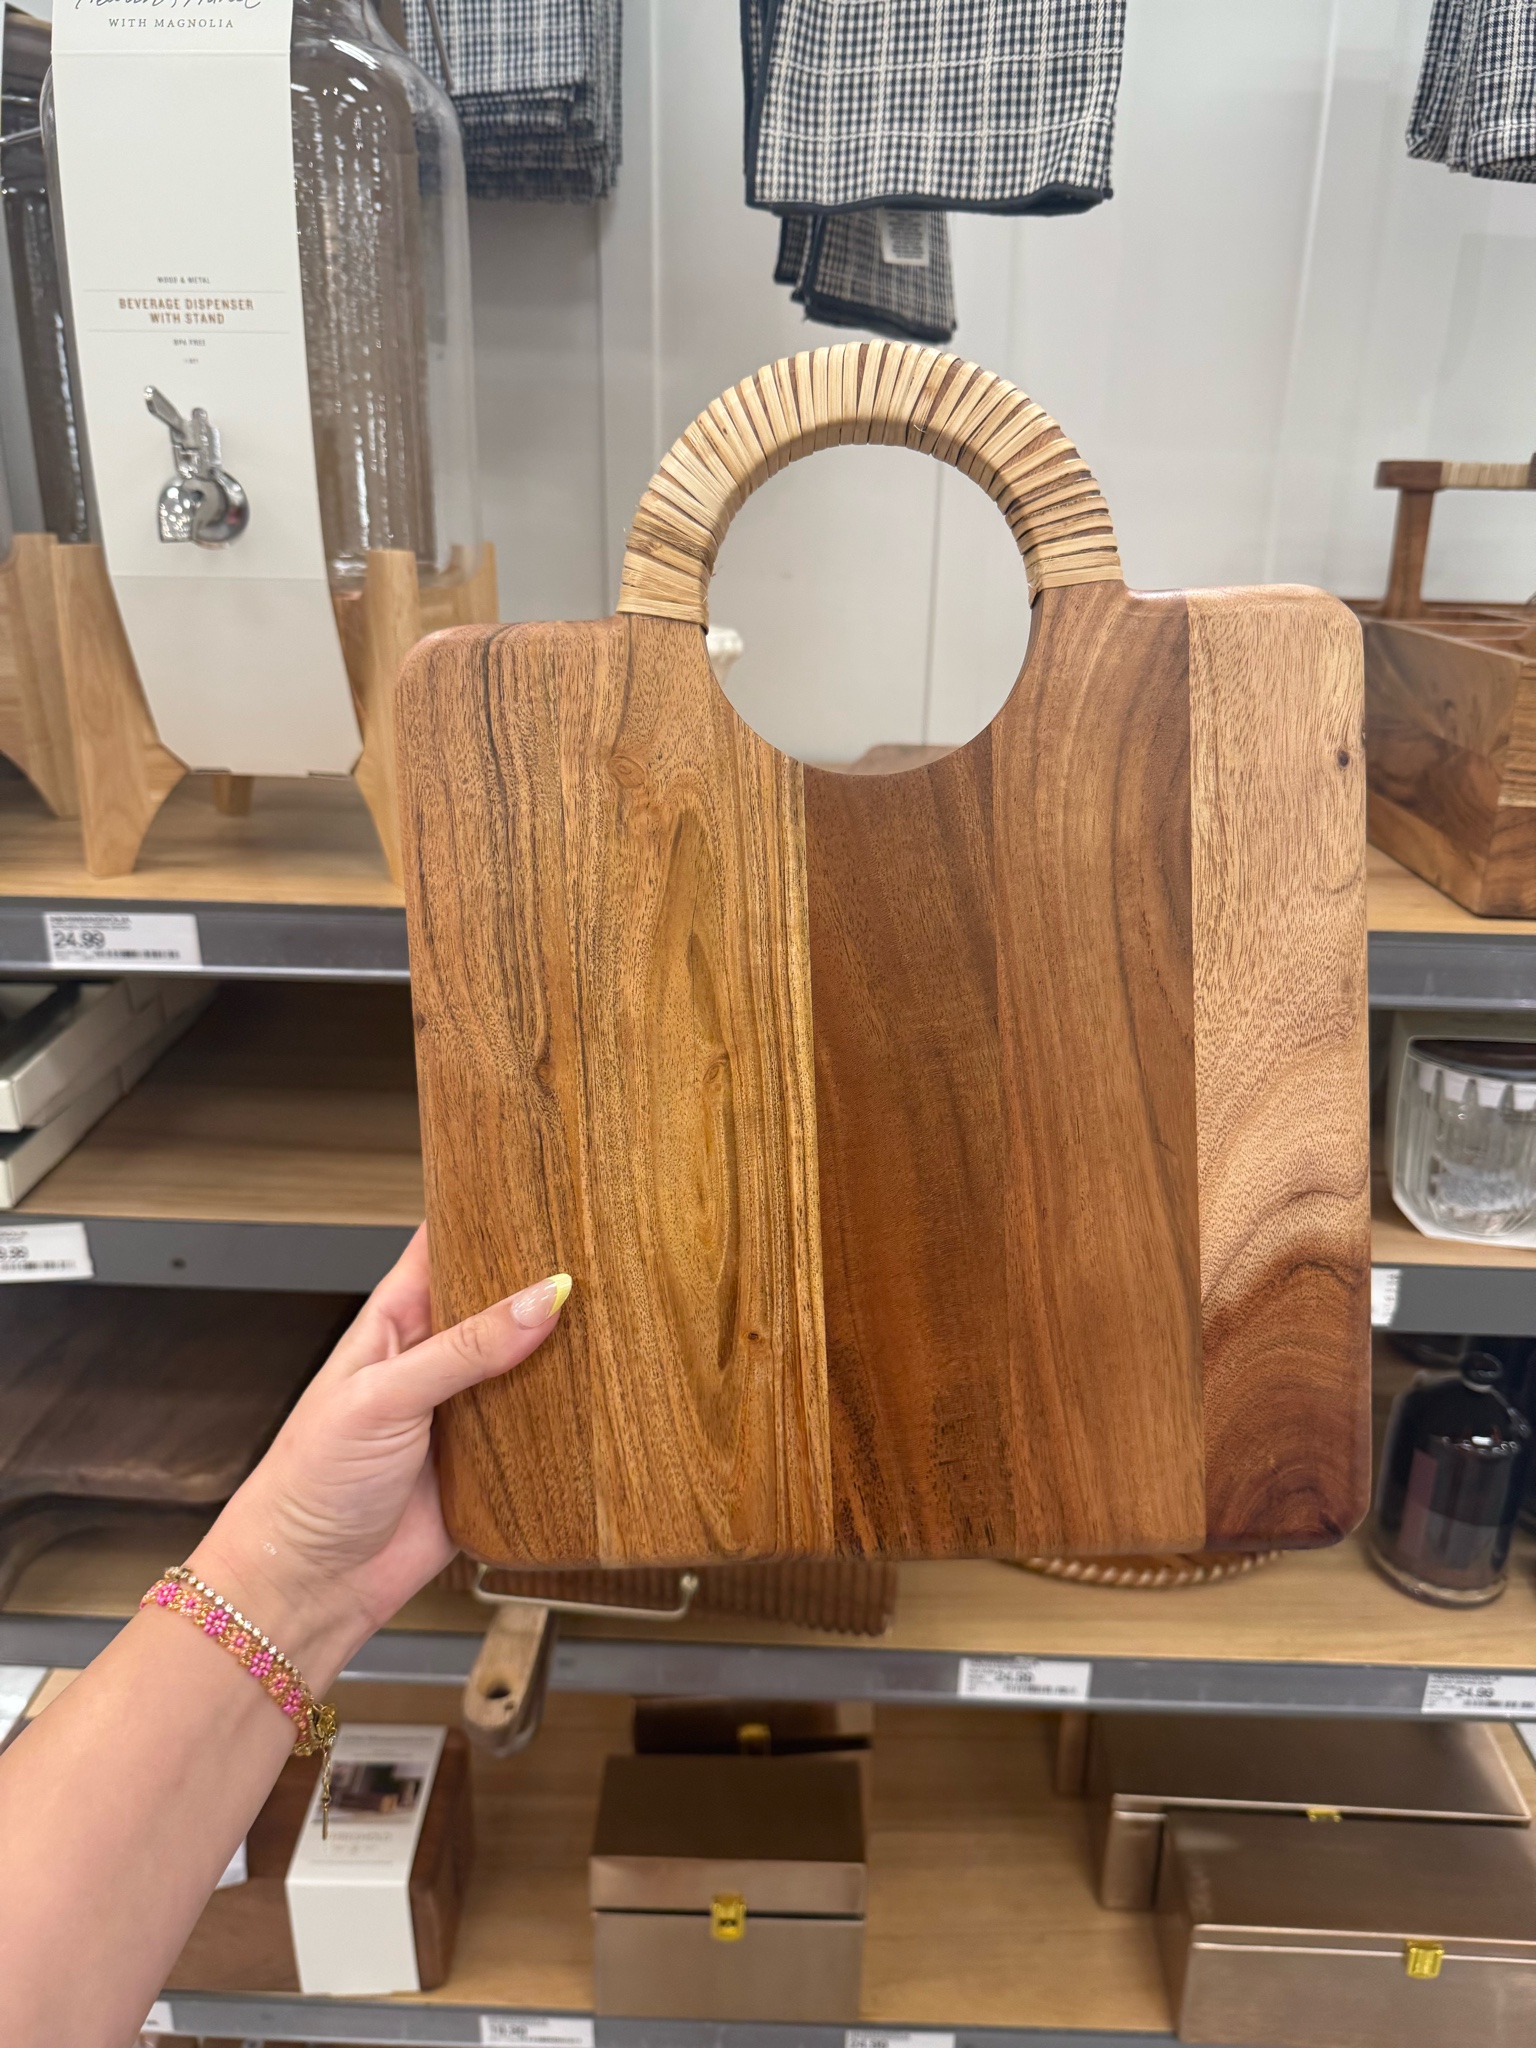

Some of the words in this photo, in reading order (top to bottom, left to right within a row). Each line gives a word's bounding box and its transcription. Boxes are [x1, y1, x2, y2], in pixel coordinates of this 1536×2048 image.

[109, 18, 147, 28] WITH
[154, 18, 234, 28] MAGNOLIA
[119, 298, 180, 310] BEVERAGE
[185, 298, 254, 311] DISPENSER
[150, 312, 181, 324] WITH
[185, 312, 225, 324] STAND
[54, 930, 105, 949] 24.99
